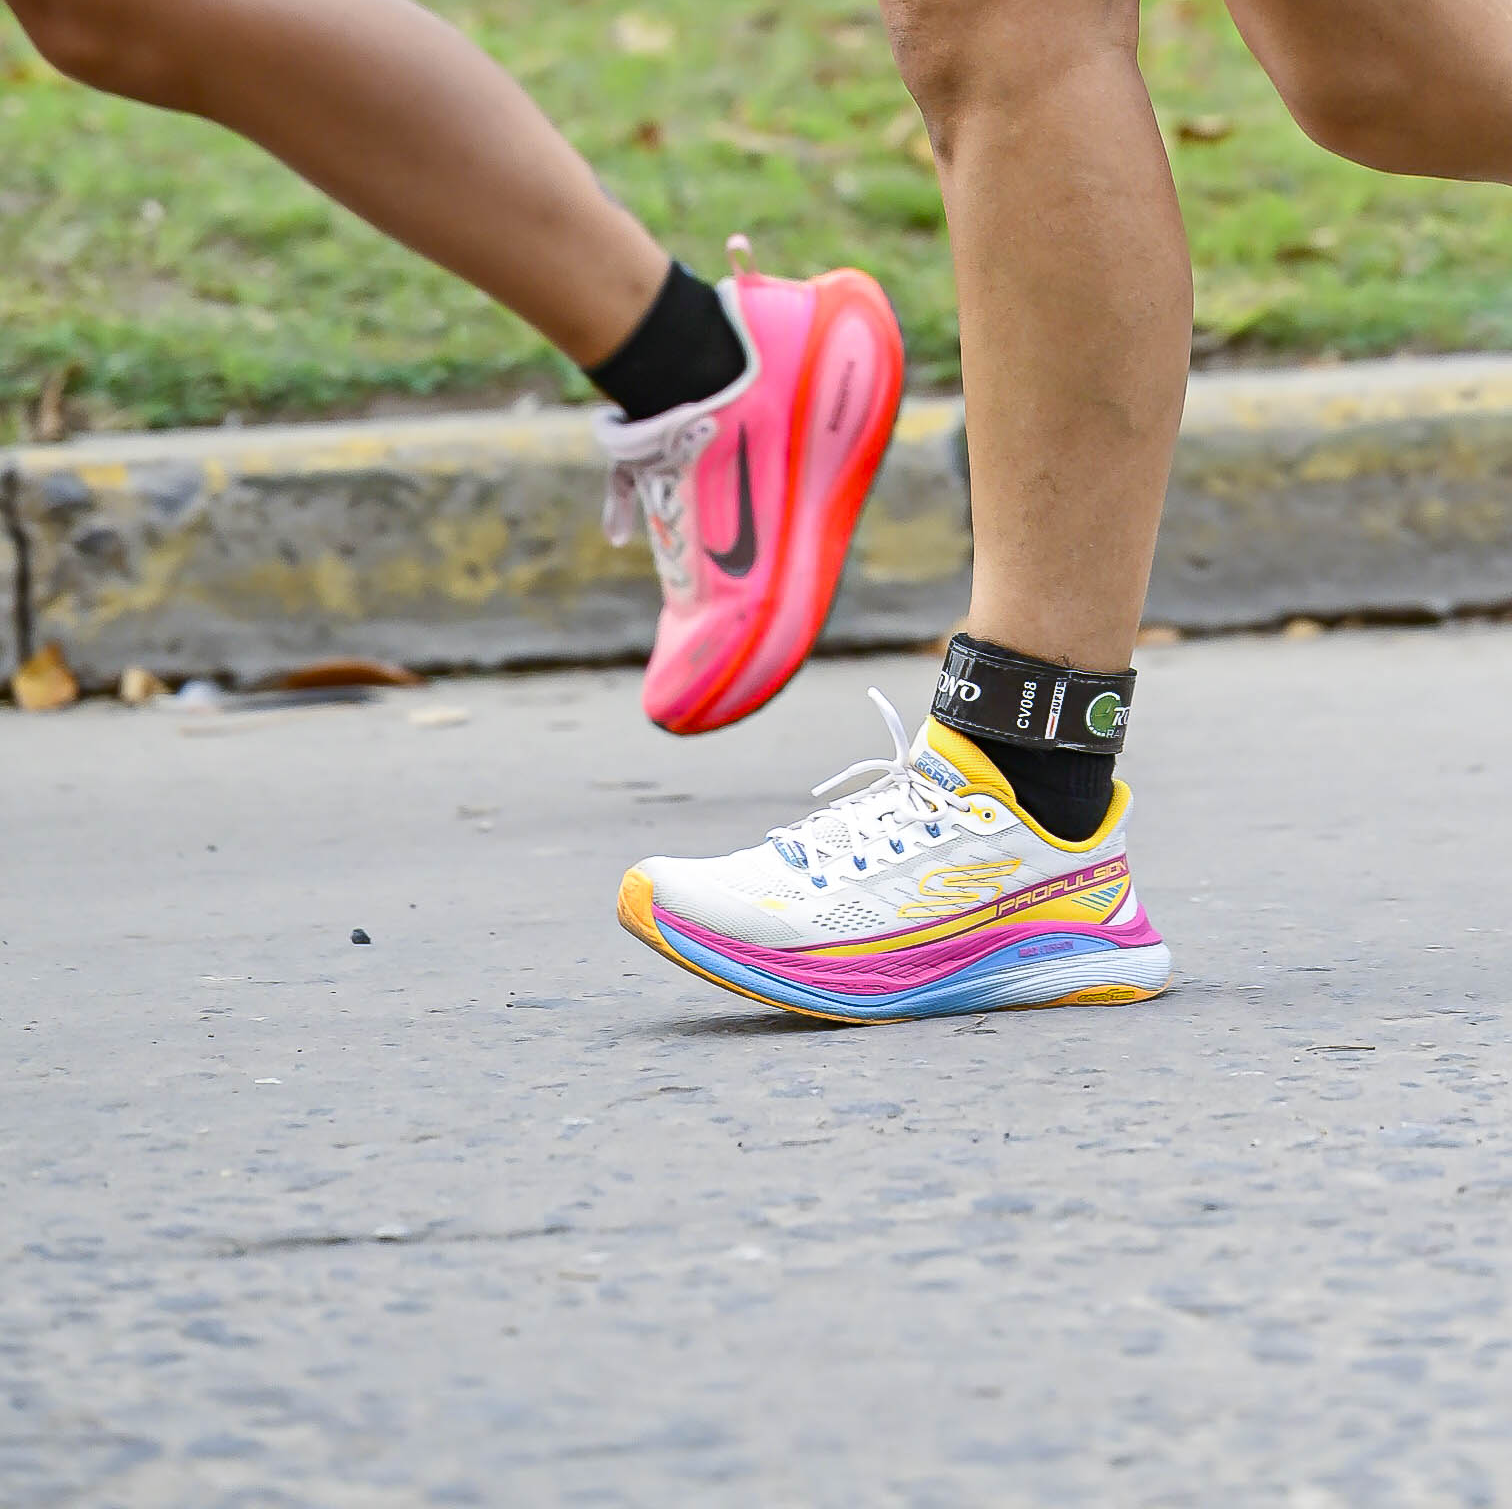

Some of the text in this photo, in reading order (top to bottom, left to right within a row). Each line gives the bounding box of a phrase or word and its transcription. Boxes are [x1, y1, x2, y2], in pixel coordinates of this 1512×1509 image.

[1016, 681, 1037, 729] CV068
[920, 751, 966, 787] SKECHER
[998, 860, 1128, 917] PROPULSION
